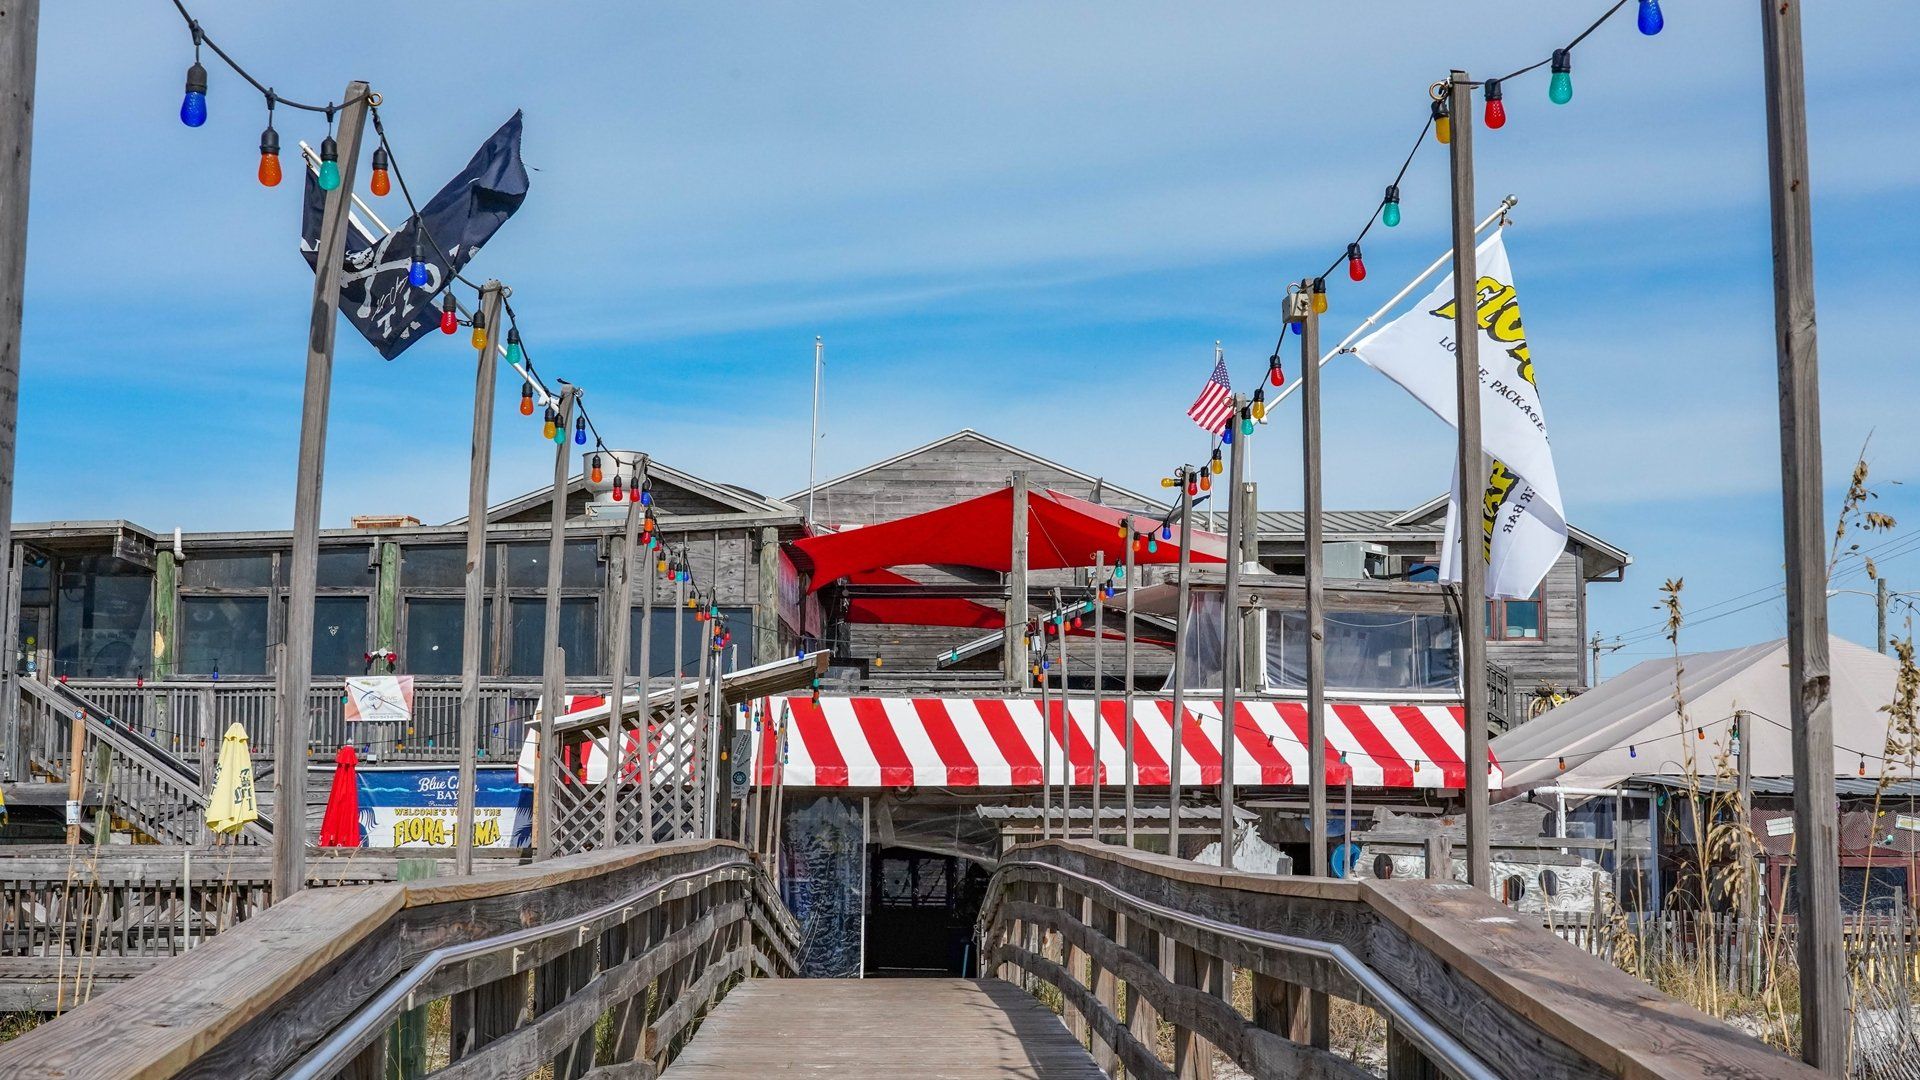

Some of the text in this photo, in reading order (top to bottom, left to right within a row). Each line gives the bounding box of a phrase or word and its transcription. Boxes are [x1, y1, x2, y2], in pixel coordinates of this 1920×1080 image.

[1490, 379, 1546, 432] PACKAGE
[417, 776, 446, 792] Blue
[436, 790, 459, 800] BAY
[394, 808, 447, 816] WELCOME'S
[483, 808, 502, 816] THE
[392, 816, 502, 848] FLORA-MA
